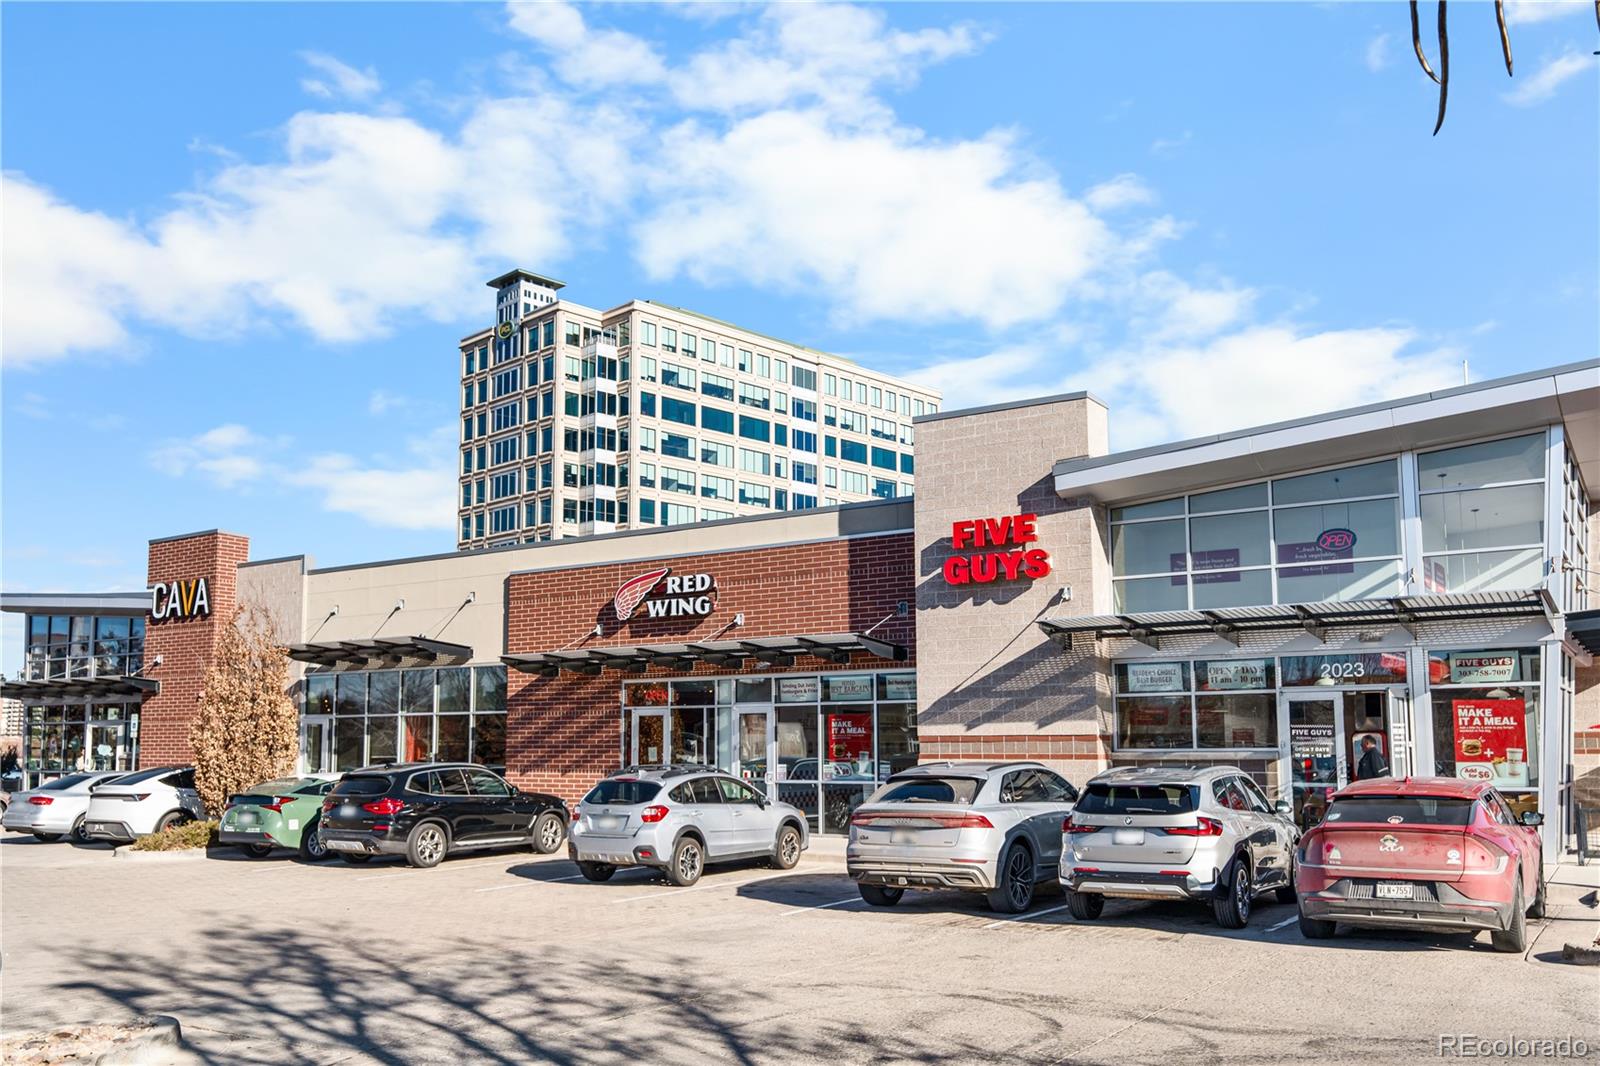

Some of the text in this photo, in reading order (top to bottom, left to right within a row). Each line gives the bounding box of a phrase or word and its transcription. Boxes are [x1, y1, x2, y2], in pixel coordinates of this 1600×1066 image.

[952, 513, 1038, 549] FIVE
[1320, 534, 1352, 547] OPEN
[943, 548, 1052, 585] GUYS
[667, 573, 711, 593] RED
[152, 577, 210, 619] CAVA
[646, 596, 711, 618] WING
[1208, 667, 1232, 675] OPEN
[1242, 666, 1265, 674] DAYS
[1320, 662, 1364, 678] 2023
[1458, 668, 1511, 676] 303-758-7007
[645, 689, 668, 701] OPEN
[1458, 708, 1492, 716] MAKE
[1458, 716, 1518, 725] IT A MEAL
